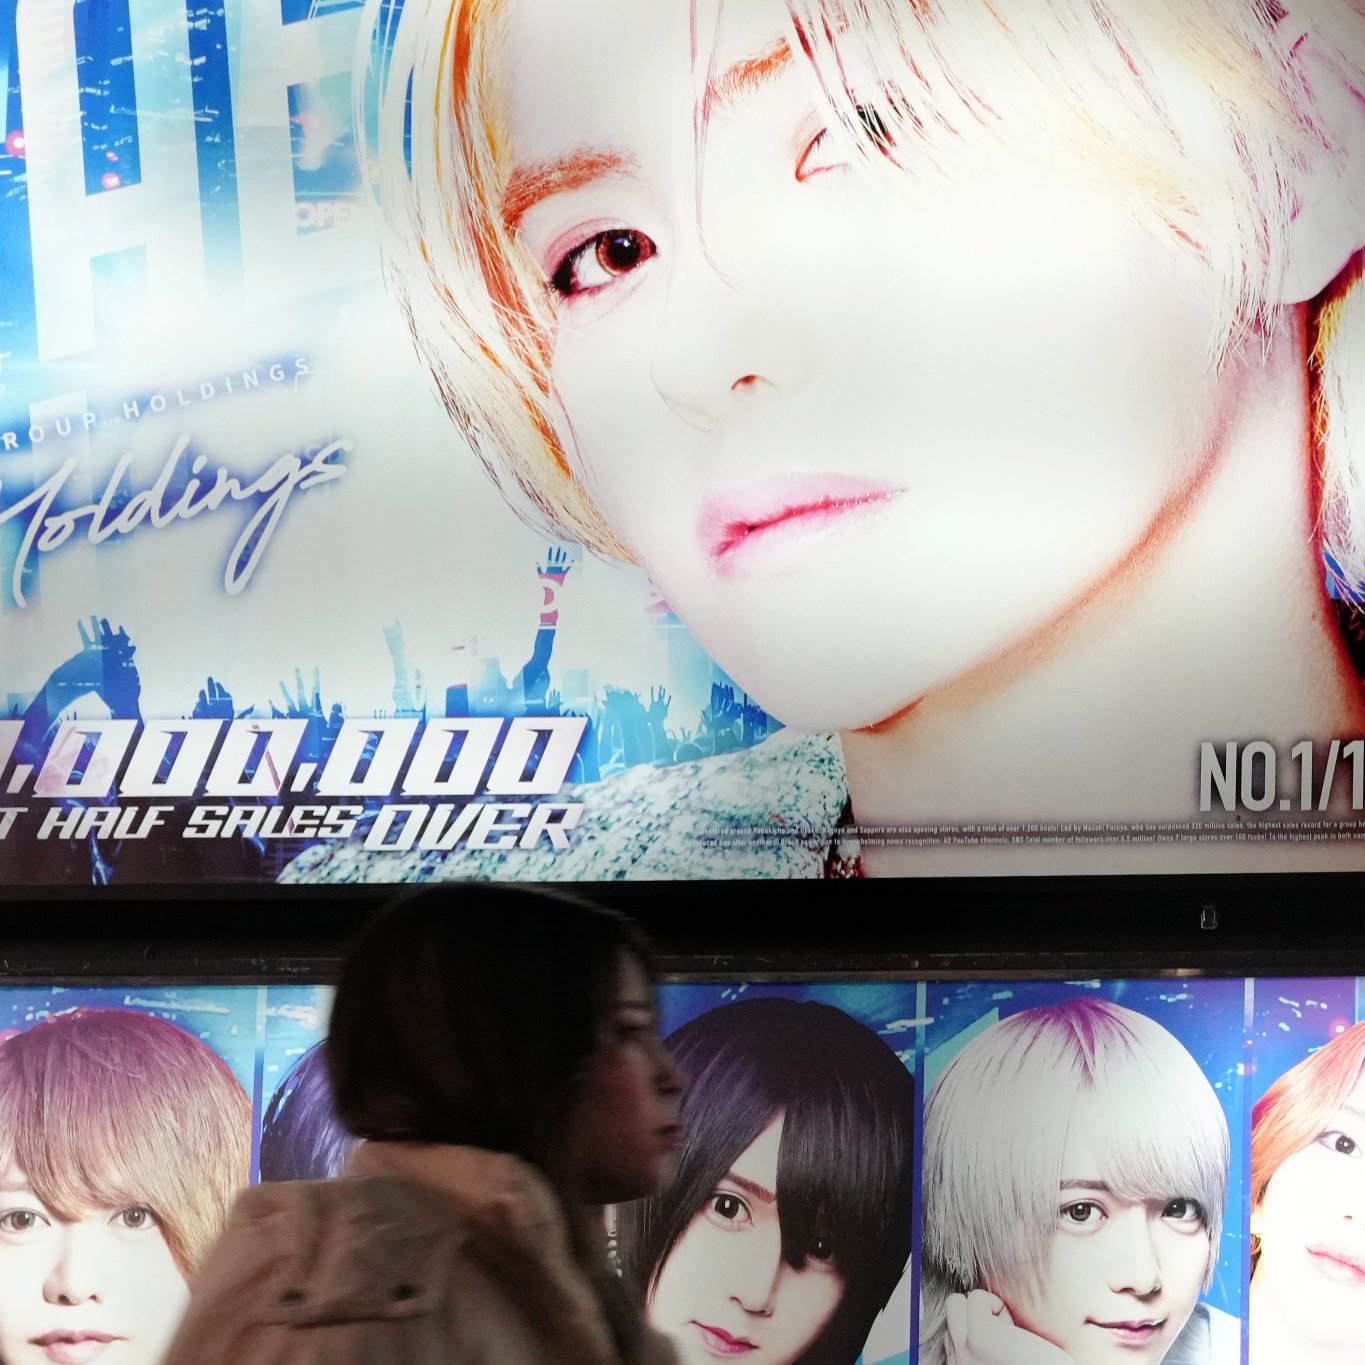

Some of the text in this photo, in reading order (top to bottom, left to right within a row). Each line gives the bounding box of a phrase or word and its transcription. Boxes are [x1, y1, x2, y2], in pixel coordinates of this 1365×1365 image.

[0, 355, 312, 453] ROUP HOLDINGS
[37, 804, 175, 839] HALF
[182, 804, 372, 839] SALES
[363, 803, 586, 852] OVER
